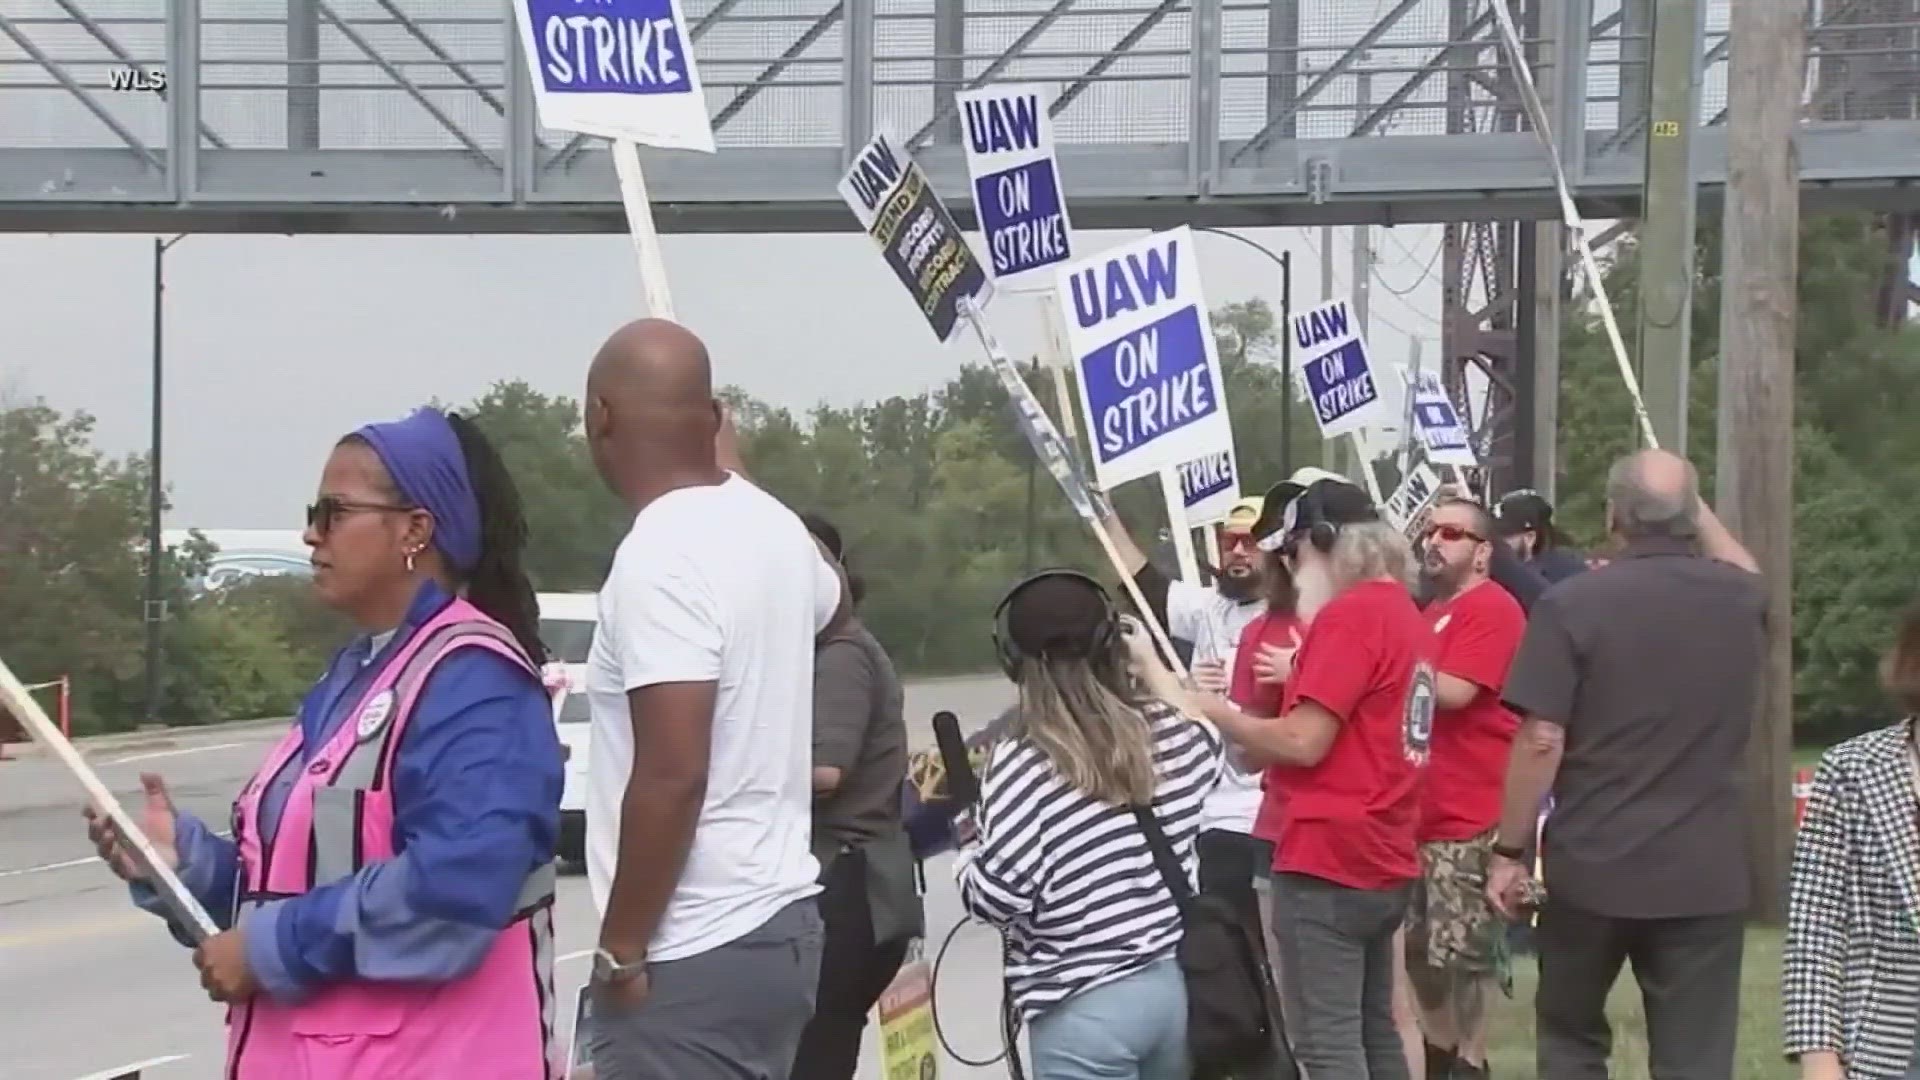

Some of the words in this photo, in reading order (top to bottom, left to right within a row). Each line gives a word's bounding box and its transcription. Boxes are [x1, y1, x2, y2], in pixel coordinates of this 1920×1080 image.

[545, 15, 681, 85] STRIKE
[965, 95, 1039, 154] UAW
[849, 133, 901, 211] UAW
[998, 169, 1031, 218] ON
[993, 213, 1065, 271] STRIKE
[1070, 240, 1177, 328] UAW
[1295, 302, 1349, 348] UAW
[1115, 327, 1158, 388] ON
[1320, 351, 1345, 385] ON
[1103, 363, 1209, 452] STRIKE
[1318, 371, 1375, 420] STRIKE
[1179, 451, 1232, 498] TRIKE
